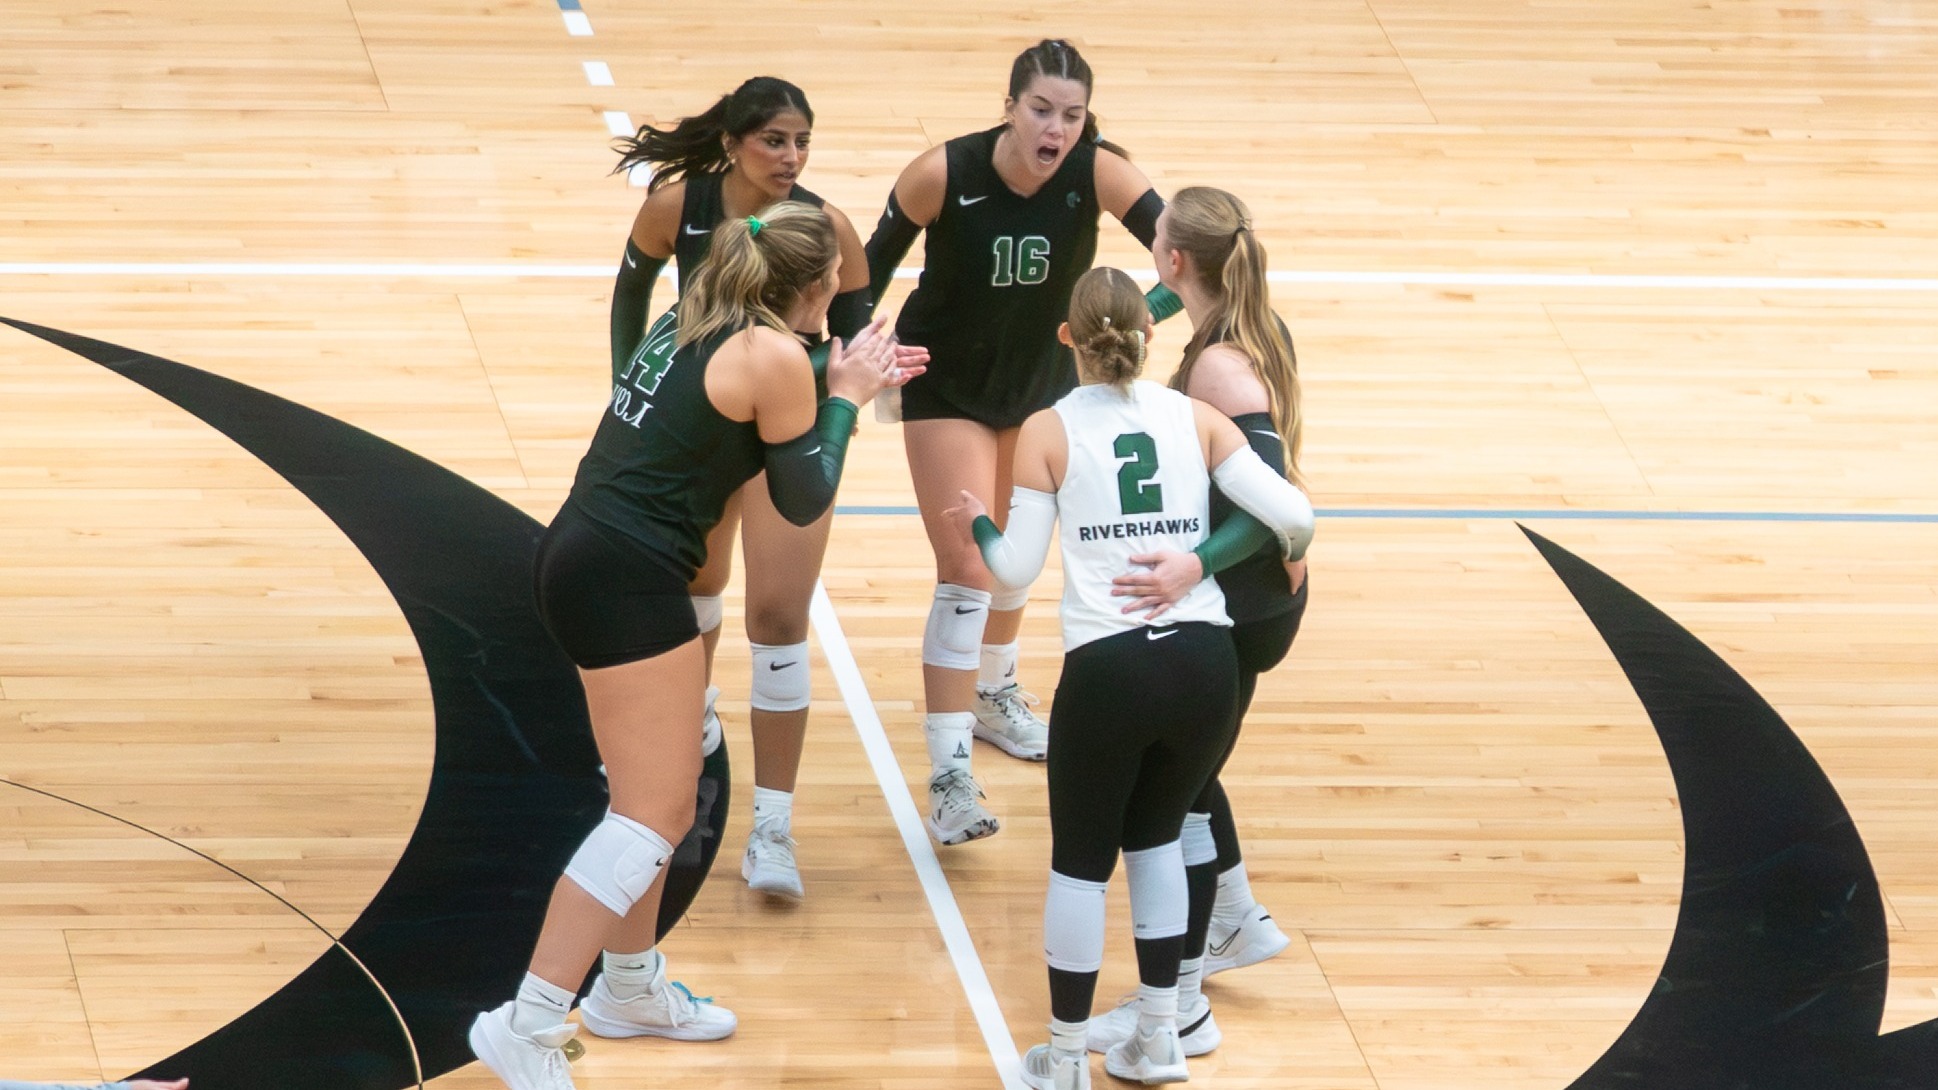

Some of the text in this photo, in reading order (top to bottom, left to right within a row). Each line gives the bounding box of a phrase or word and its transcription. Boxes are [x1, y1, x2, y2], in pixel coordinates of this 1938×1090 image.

[992, 235, 1050, 287] 16
[620, 311, 680, 396] 14
[1113, 431, 1163, 515] 2
[1079, 518, 1200, 541] RIVERHAWKS
